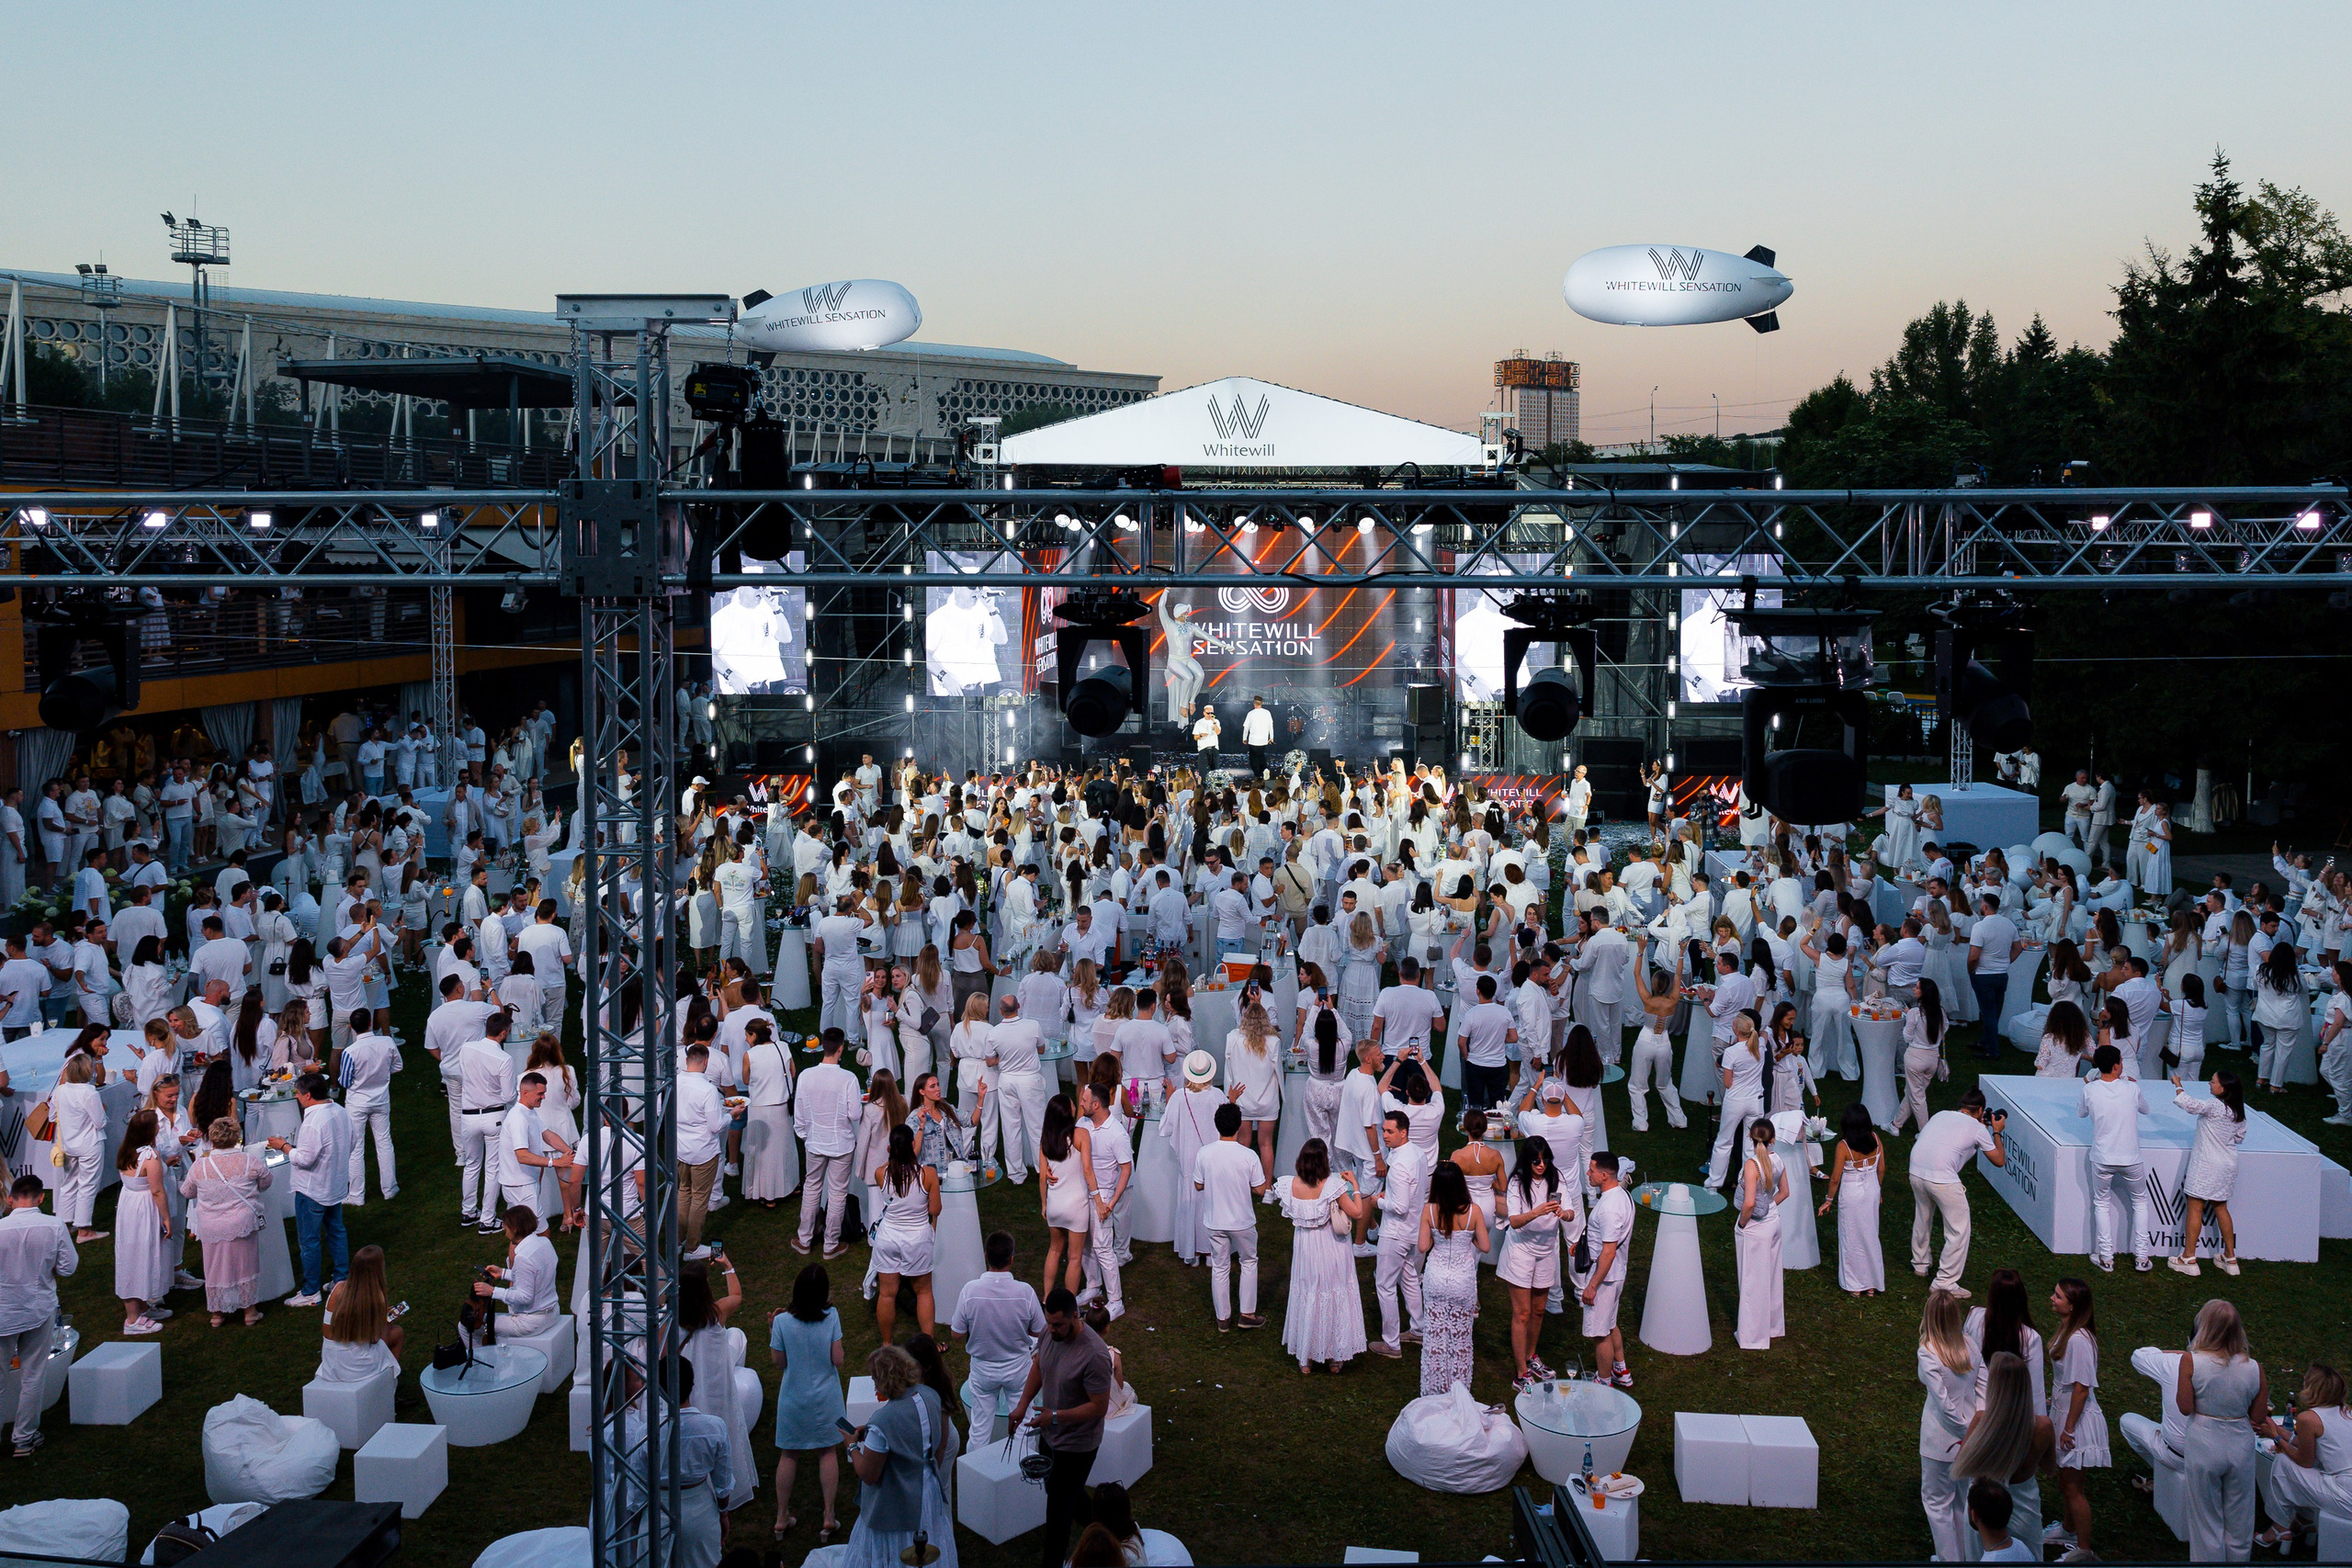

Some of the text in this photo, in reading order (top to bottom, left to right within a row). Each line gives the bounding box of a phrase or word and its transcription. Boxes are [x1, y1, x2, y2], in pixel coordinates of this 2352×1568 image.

[1605, 281, 1742, 292] WHITEWILL SENSATION
[765, 309, 886, 333] WHITEWILL SENSATION
[1203, 444, 1275, 457] Whitewill
[1487, 788, 1543, 797] HITEILL
